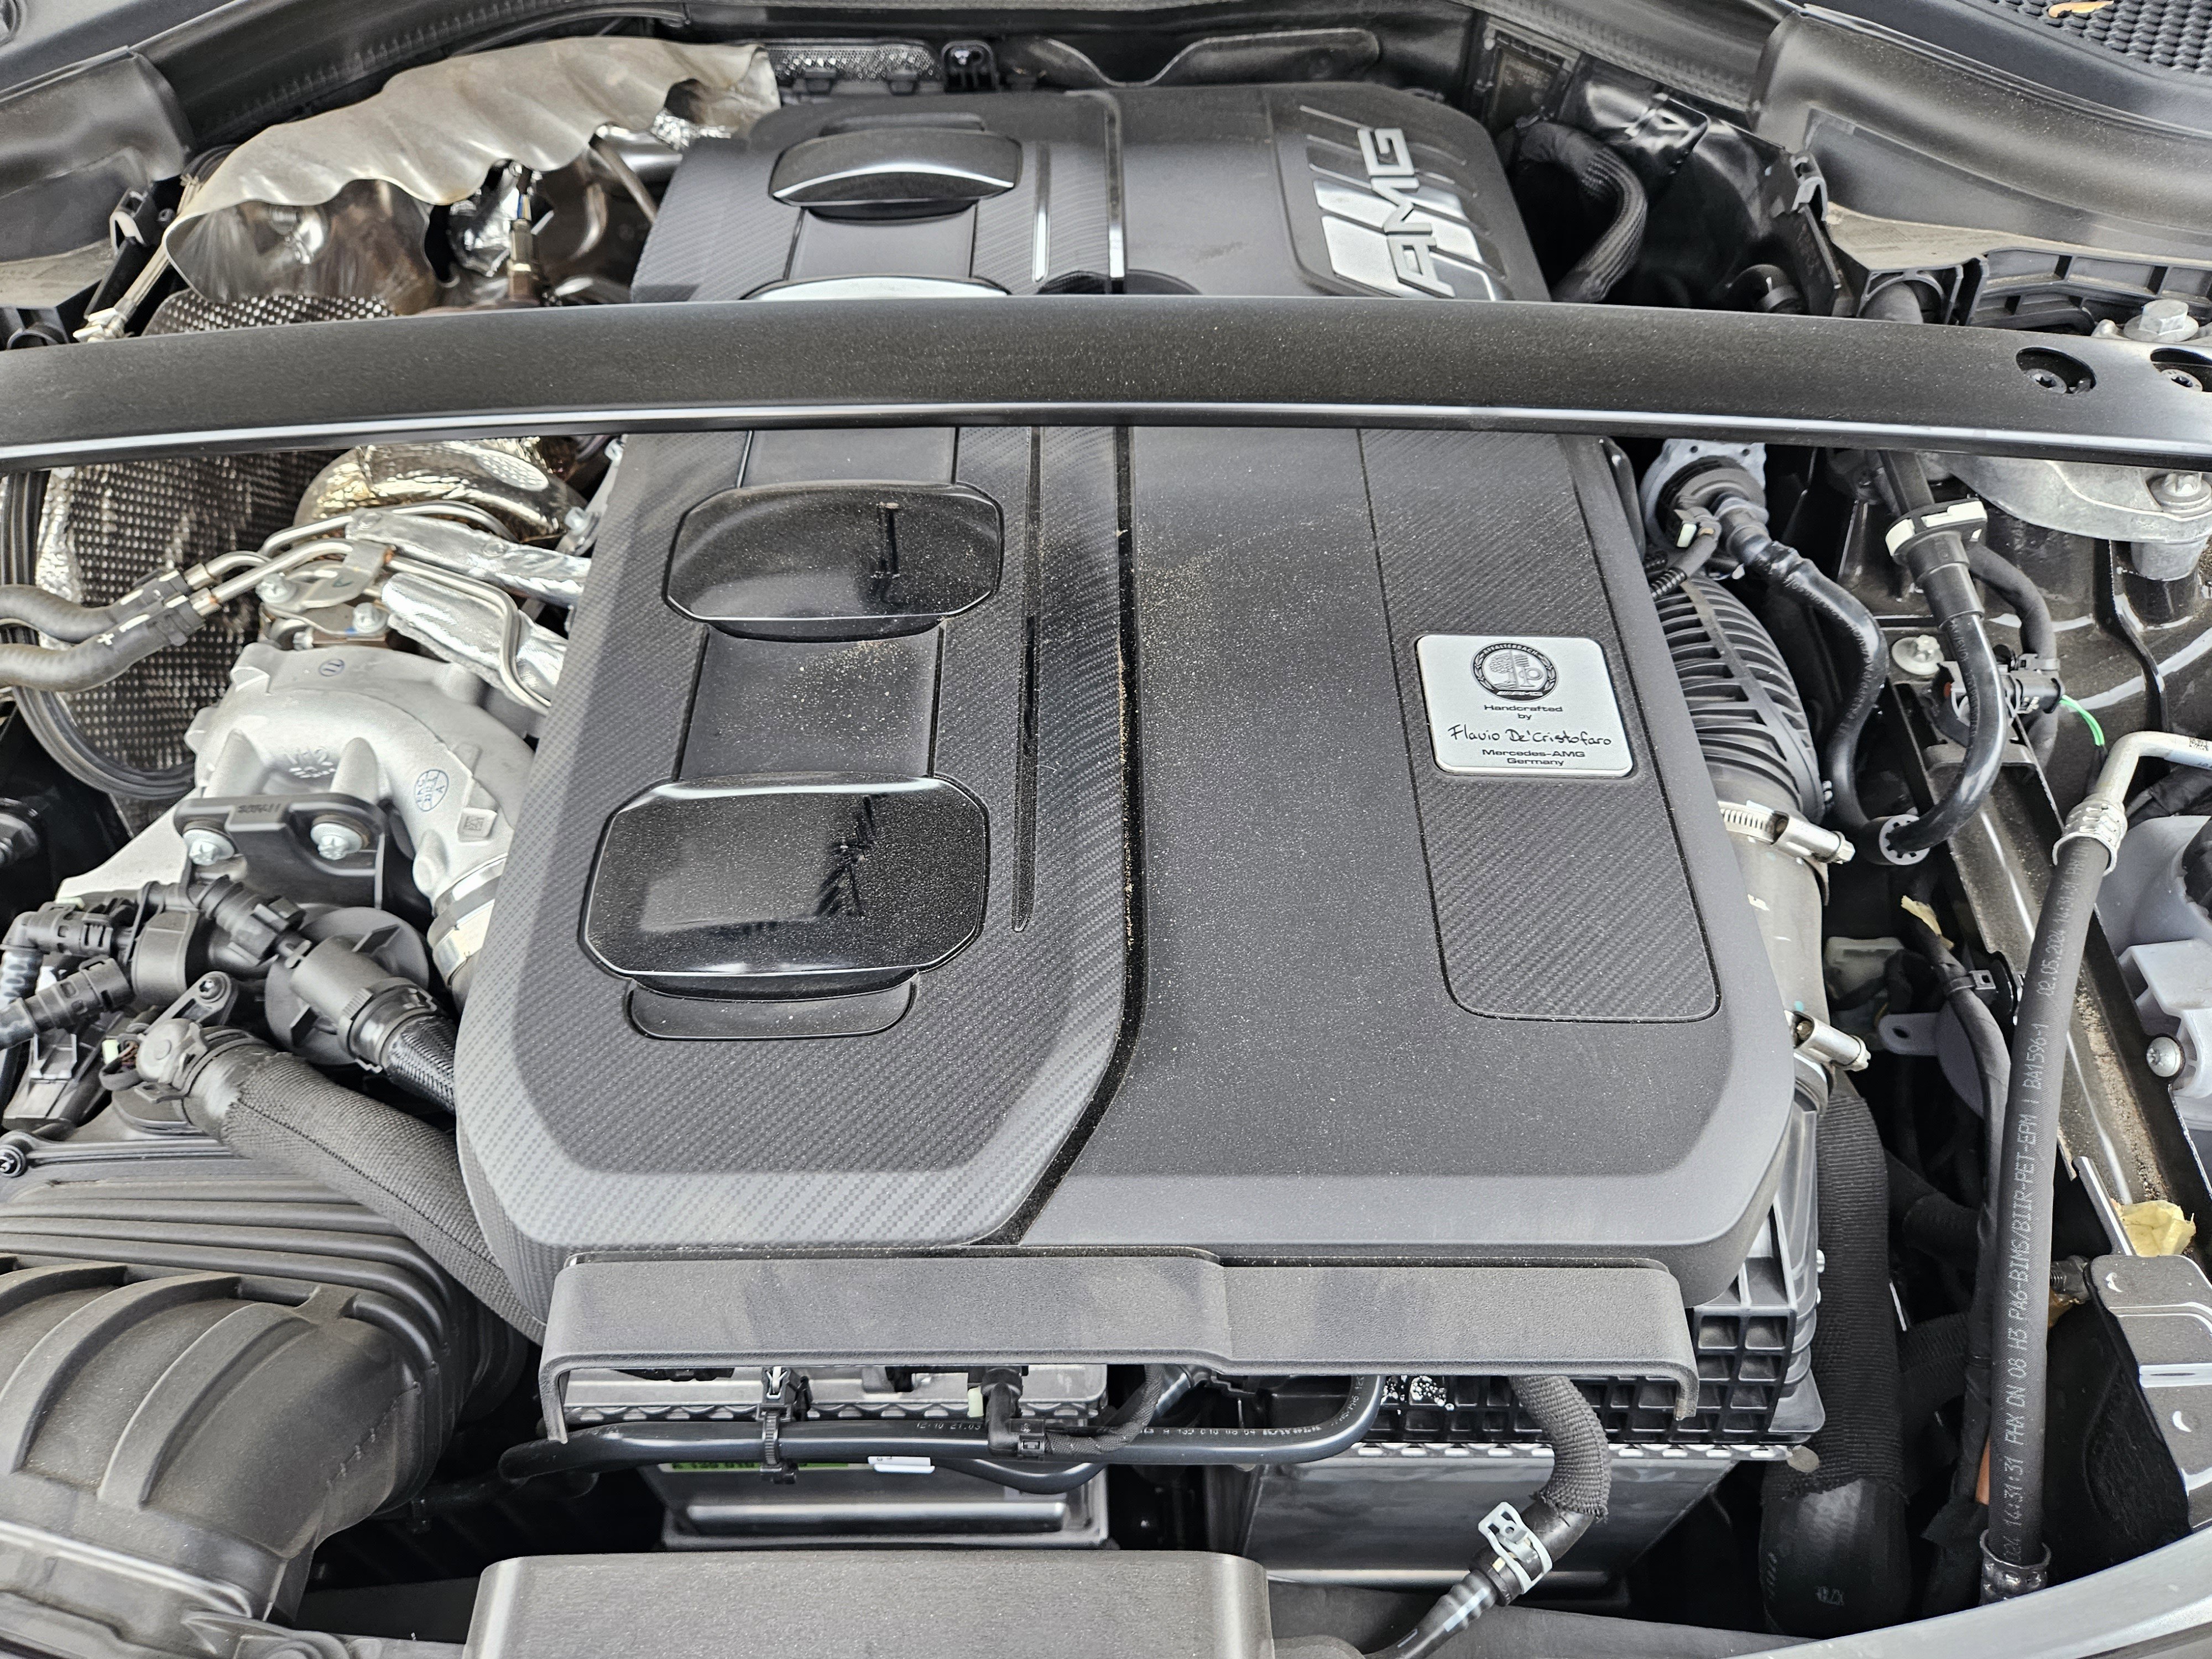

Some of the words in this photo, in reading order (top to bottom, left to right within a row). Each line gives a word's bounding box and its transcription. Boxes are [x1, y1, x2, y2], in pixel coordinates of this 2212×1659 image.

[1357, 128, 1455, 298] AMG
[1483, 644, 1538, 656] AFFALTERBACH
[1517, 712, 1532, 721] by
[1447, 724, 1500, 741] Flavio
[1481, 749, 1585, 758] Mercedes-AMG
[1506, 758, 1565, 766] Germany
[2007, 1357, 2027, 1379] 08
[2036, 930, 2067, 996] 02.05.2024
